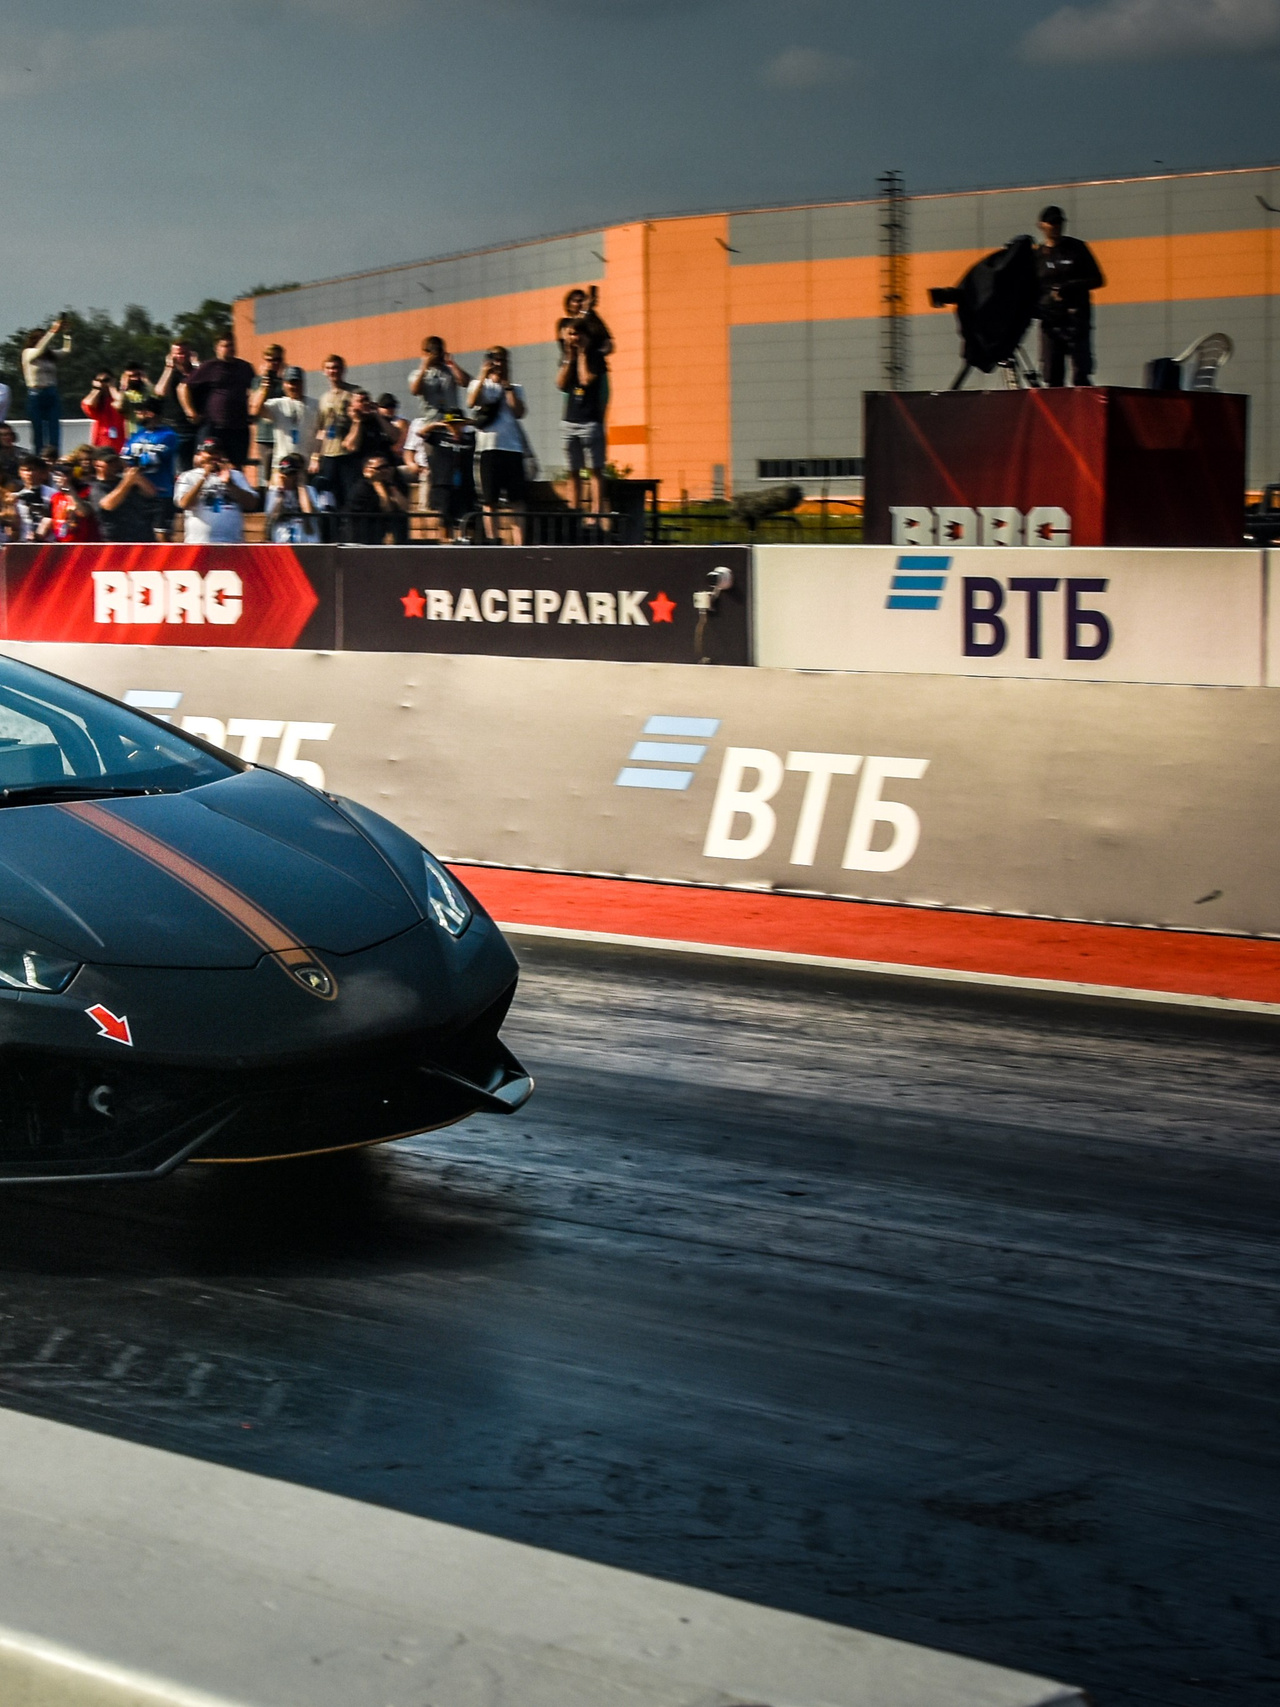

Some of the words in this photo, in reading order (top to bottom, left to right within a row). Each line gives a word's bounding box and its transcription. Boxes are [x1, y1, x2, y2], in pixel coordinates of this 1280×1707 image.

[889, 506, 1072, 546] RDRC
[91, 569, 243, 625] RDRC
[424, 588, 650, 626] RACEPARK
[961, 576, 1112, 661] ВТБ
[702, 746, 931, 873] ВТБ
